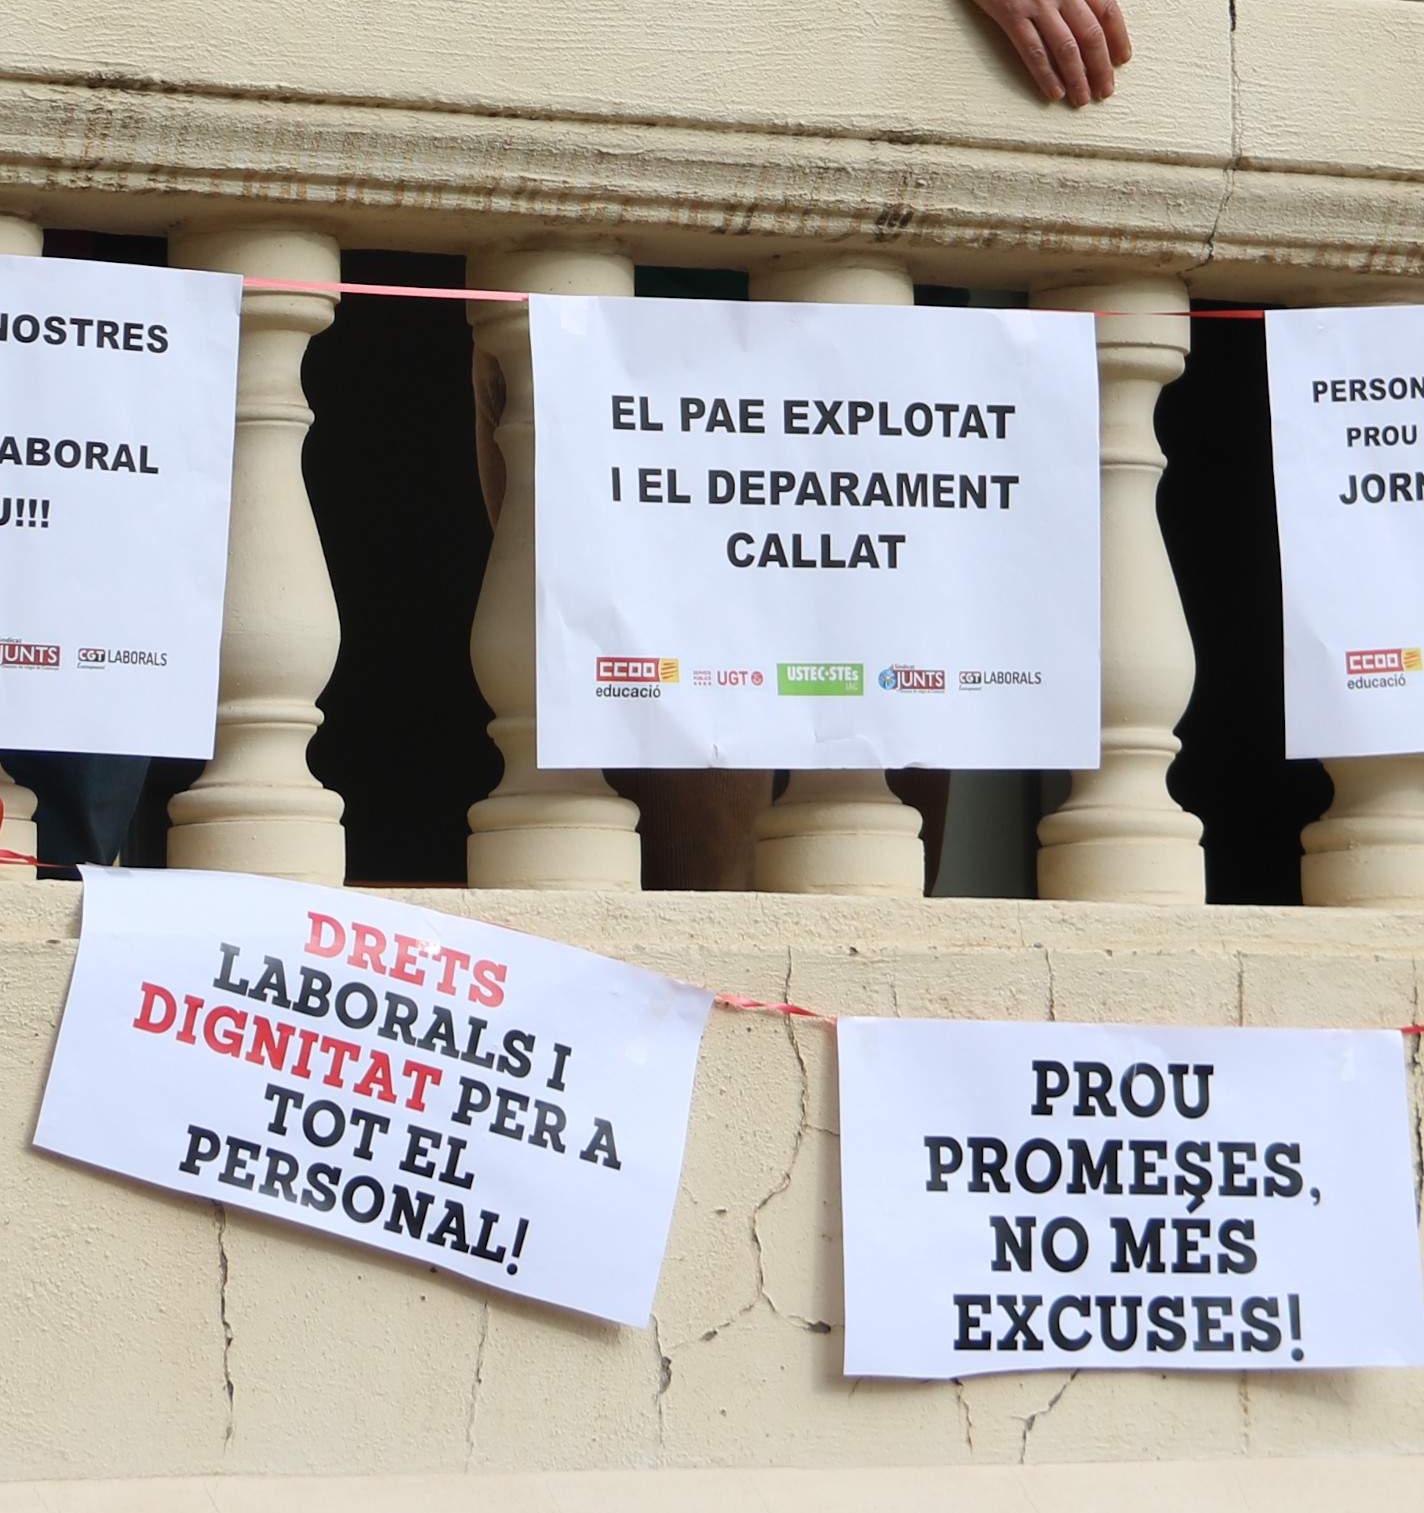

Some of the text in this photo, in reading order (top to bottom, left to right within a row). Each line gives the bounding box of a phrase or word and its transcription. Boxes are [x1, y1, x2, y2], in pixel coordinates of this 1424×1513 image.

[612, 396, 1015, 439] EL PAE EXPLOTAT
[1346, 424, 1418, 447] PROU
[612, 467, 1019, 509] I EL DEPARAMENT
[727, 533, 906, 569] CALLAT
[79, 650, 104, 662] CGT
[108, 651, 167, 666] LABORALS
[600, 662, 655, 677] CCOO
[717, 671, 748, 685] UGT
[960, 672, 1042, 685] CGT LABORALS
[1349, 653, 1398, 670] CCOO
[596, 685, 661, 698] educació
[896, 671, 944, 689] JUNTS
[1348, 674, 1406, 689] educació
[304, 911, 508, 1008] DRETS
[213, 942, 572, 1092] LABORALS I
[132, 981, 622, 1171] DIGNITAT PER A
[1030, 1060, 1214, 1118] PROU
[264, 1083, 475, 1190] TOT EL
[924, 1136, 1322, 1206] PROMESES,
[179, 1124, 531, 1276] PERSONAL!
[990, 1196, 1258, 1275] NO MÉS
[952, 1294, 1304, 1362] EXCUSES!
